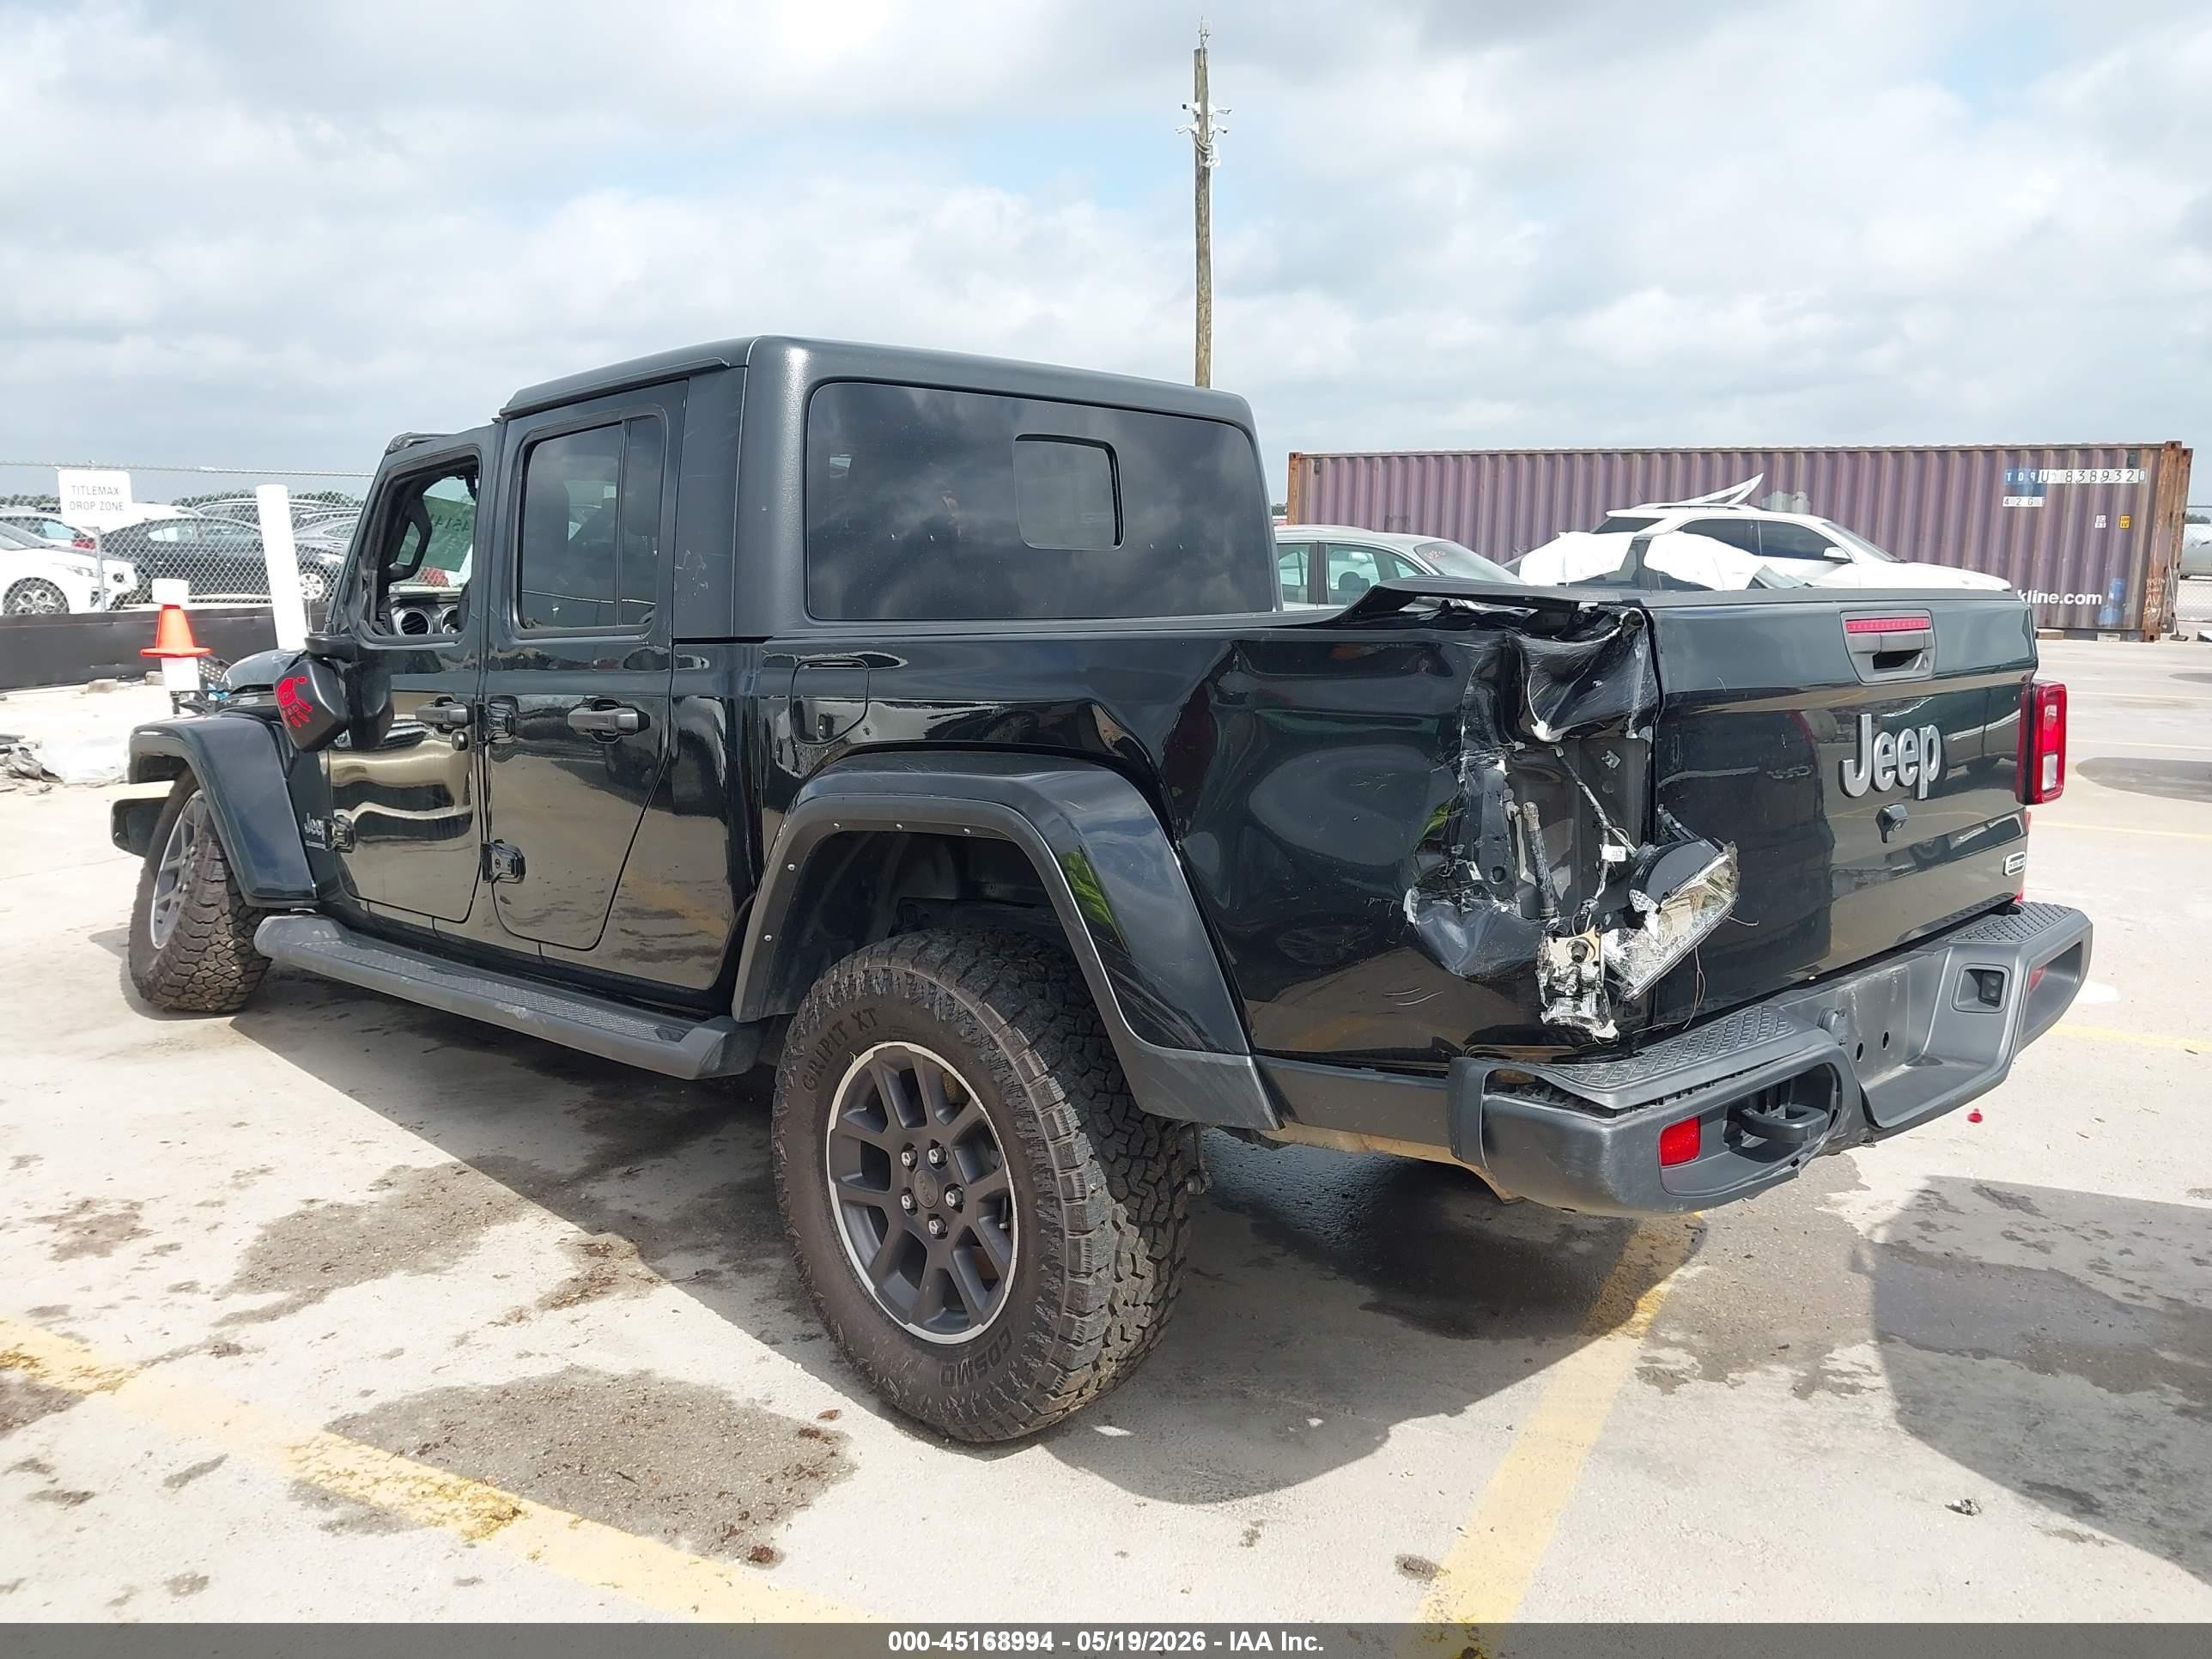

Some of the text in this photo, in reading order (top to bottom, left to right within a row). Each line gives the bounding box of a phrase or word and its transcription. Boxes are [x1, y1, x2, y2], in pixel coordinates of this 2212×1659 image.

[70, 485, 119, 495] TITLEMAX
[70, 501, 125, 512] DROP ZONE
[1838, 713, 1942, 800] Jeep
[850, 1007, 878, 1031] XT
